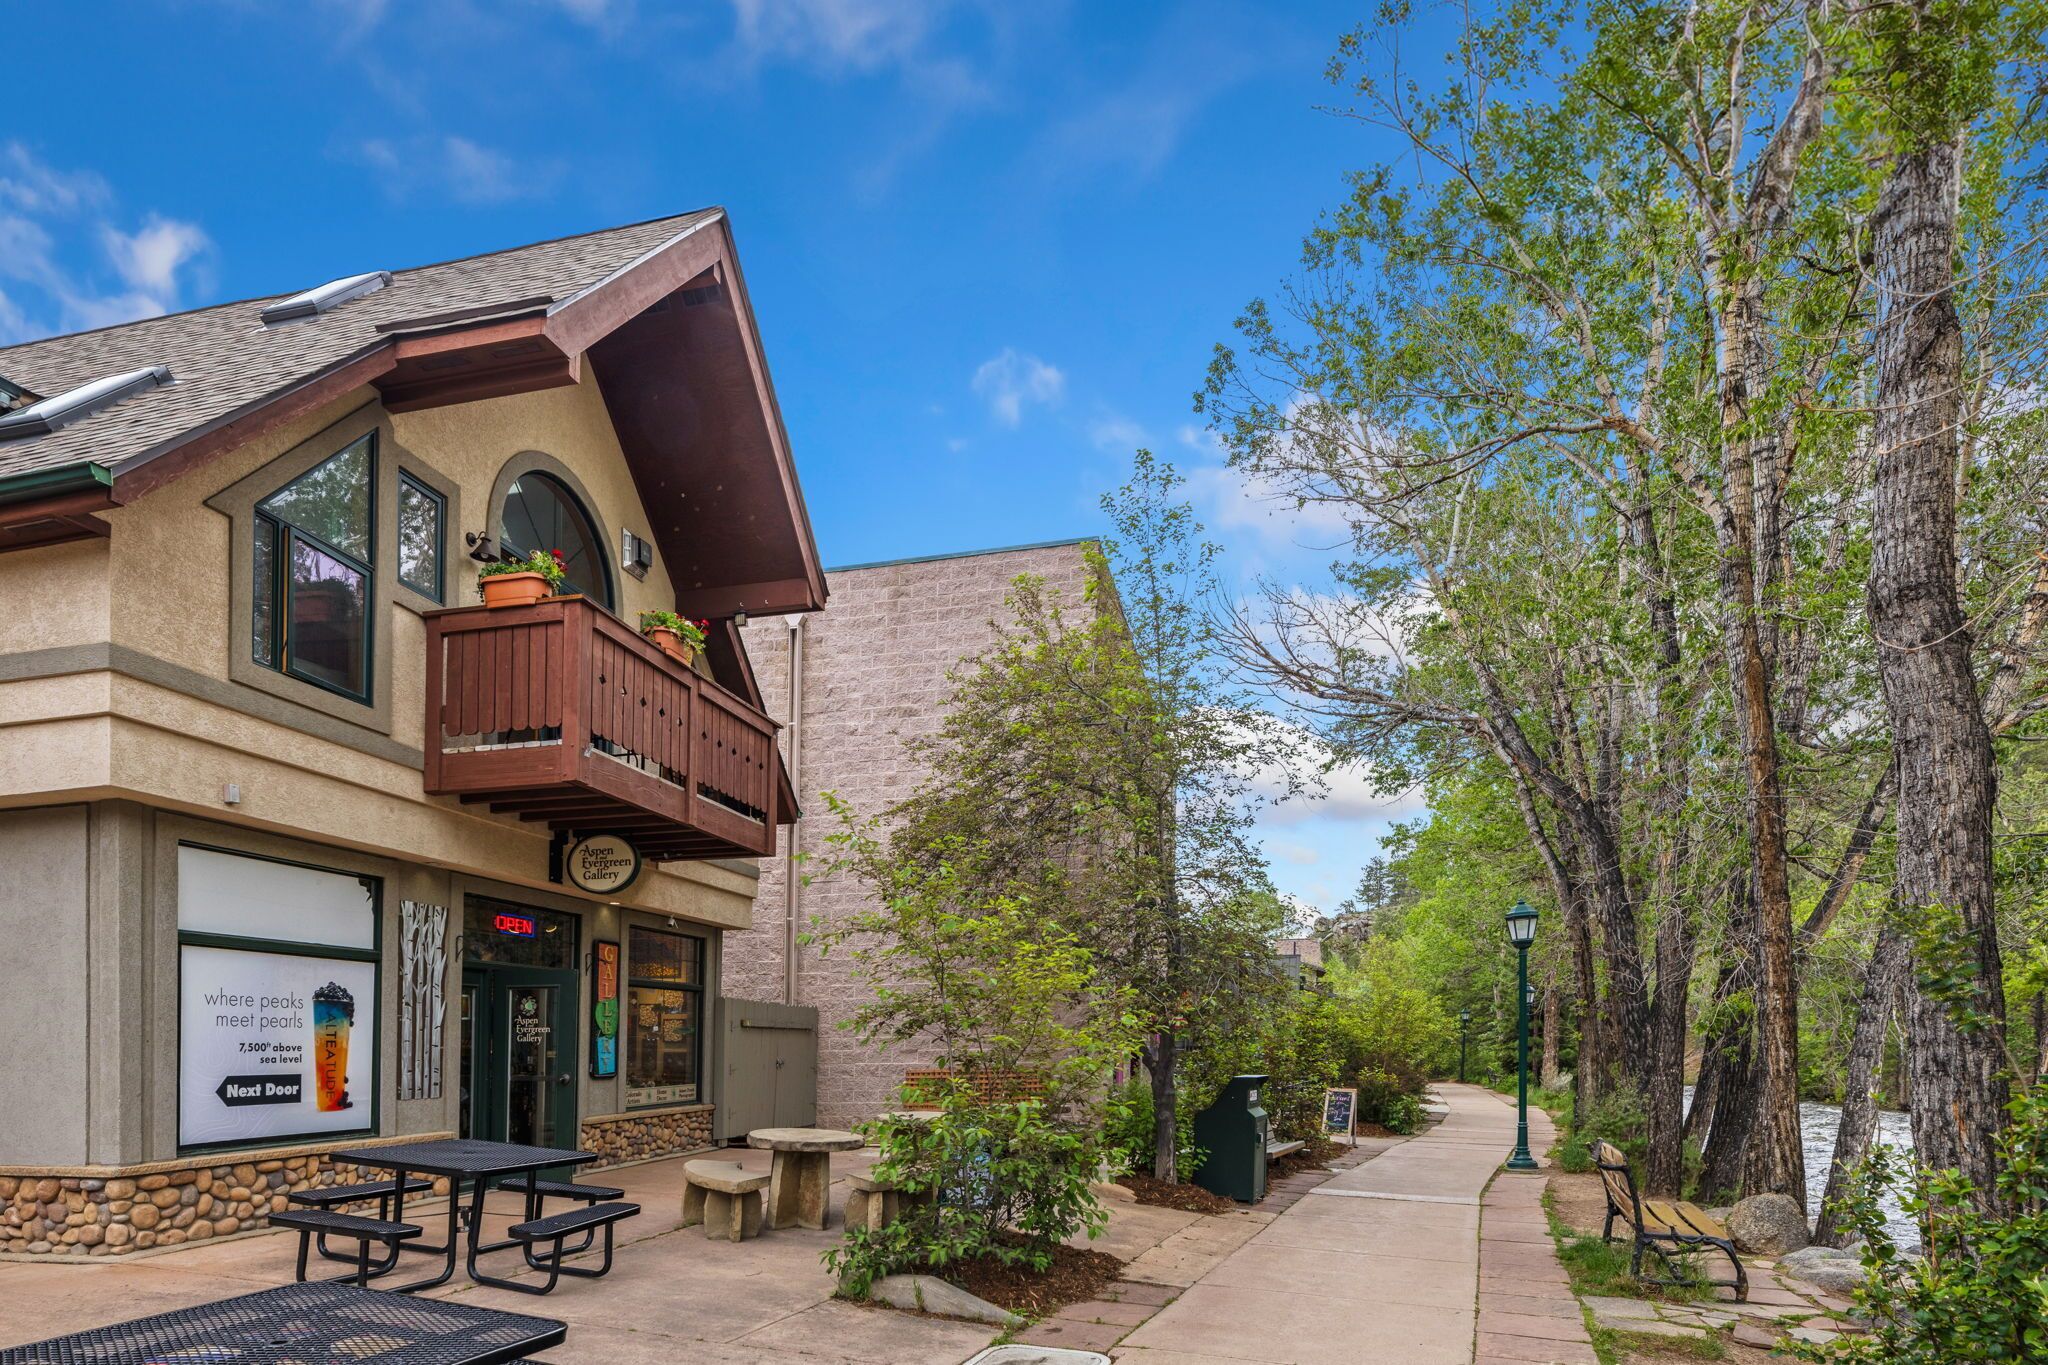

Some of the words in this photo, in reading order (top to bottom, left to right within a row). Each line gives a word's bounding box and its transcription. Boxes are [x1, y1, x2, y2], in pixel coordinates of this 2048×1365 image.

[579, 844, 614, 860] Aspen
[582, 856, 632, 870] Evergreen
[583, 869, 619, 883] Gallery
[496, 915, 532, 934] OPEN
[205, 987, 254, 1007] where
[260, 991, 304, 1012] peaks
[216, 1013, 254, 1027] meet
[260, 1011, 303, 1032] pearls
[514, 1015, 539, 1027] Aspen
[516, 1024, 551, 1035] Evergreen
[516, 1033, 543, 1045] Gallery
[272, 1043, 302, 1052] above
[260, 1056, 277, 1064] sea
[279, 1054, 302, 1064] level
[325, 1013, 337, 1099] ALTEATUDE
[226, 1084, 262, 1098] Next
[265, 1083, 299, 1096] Door
